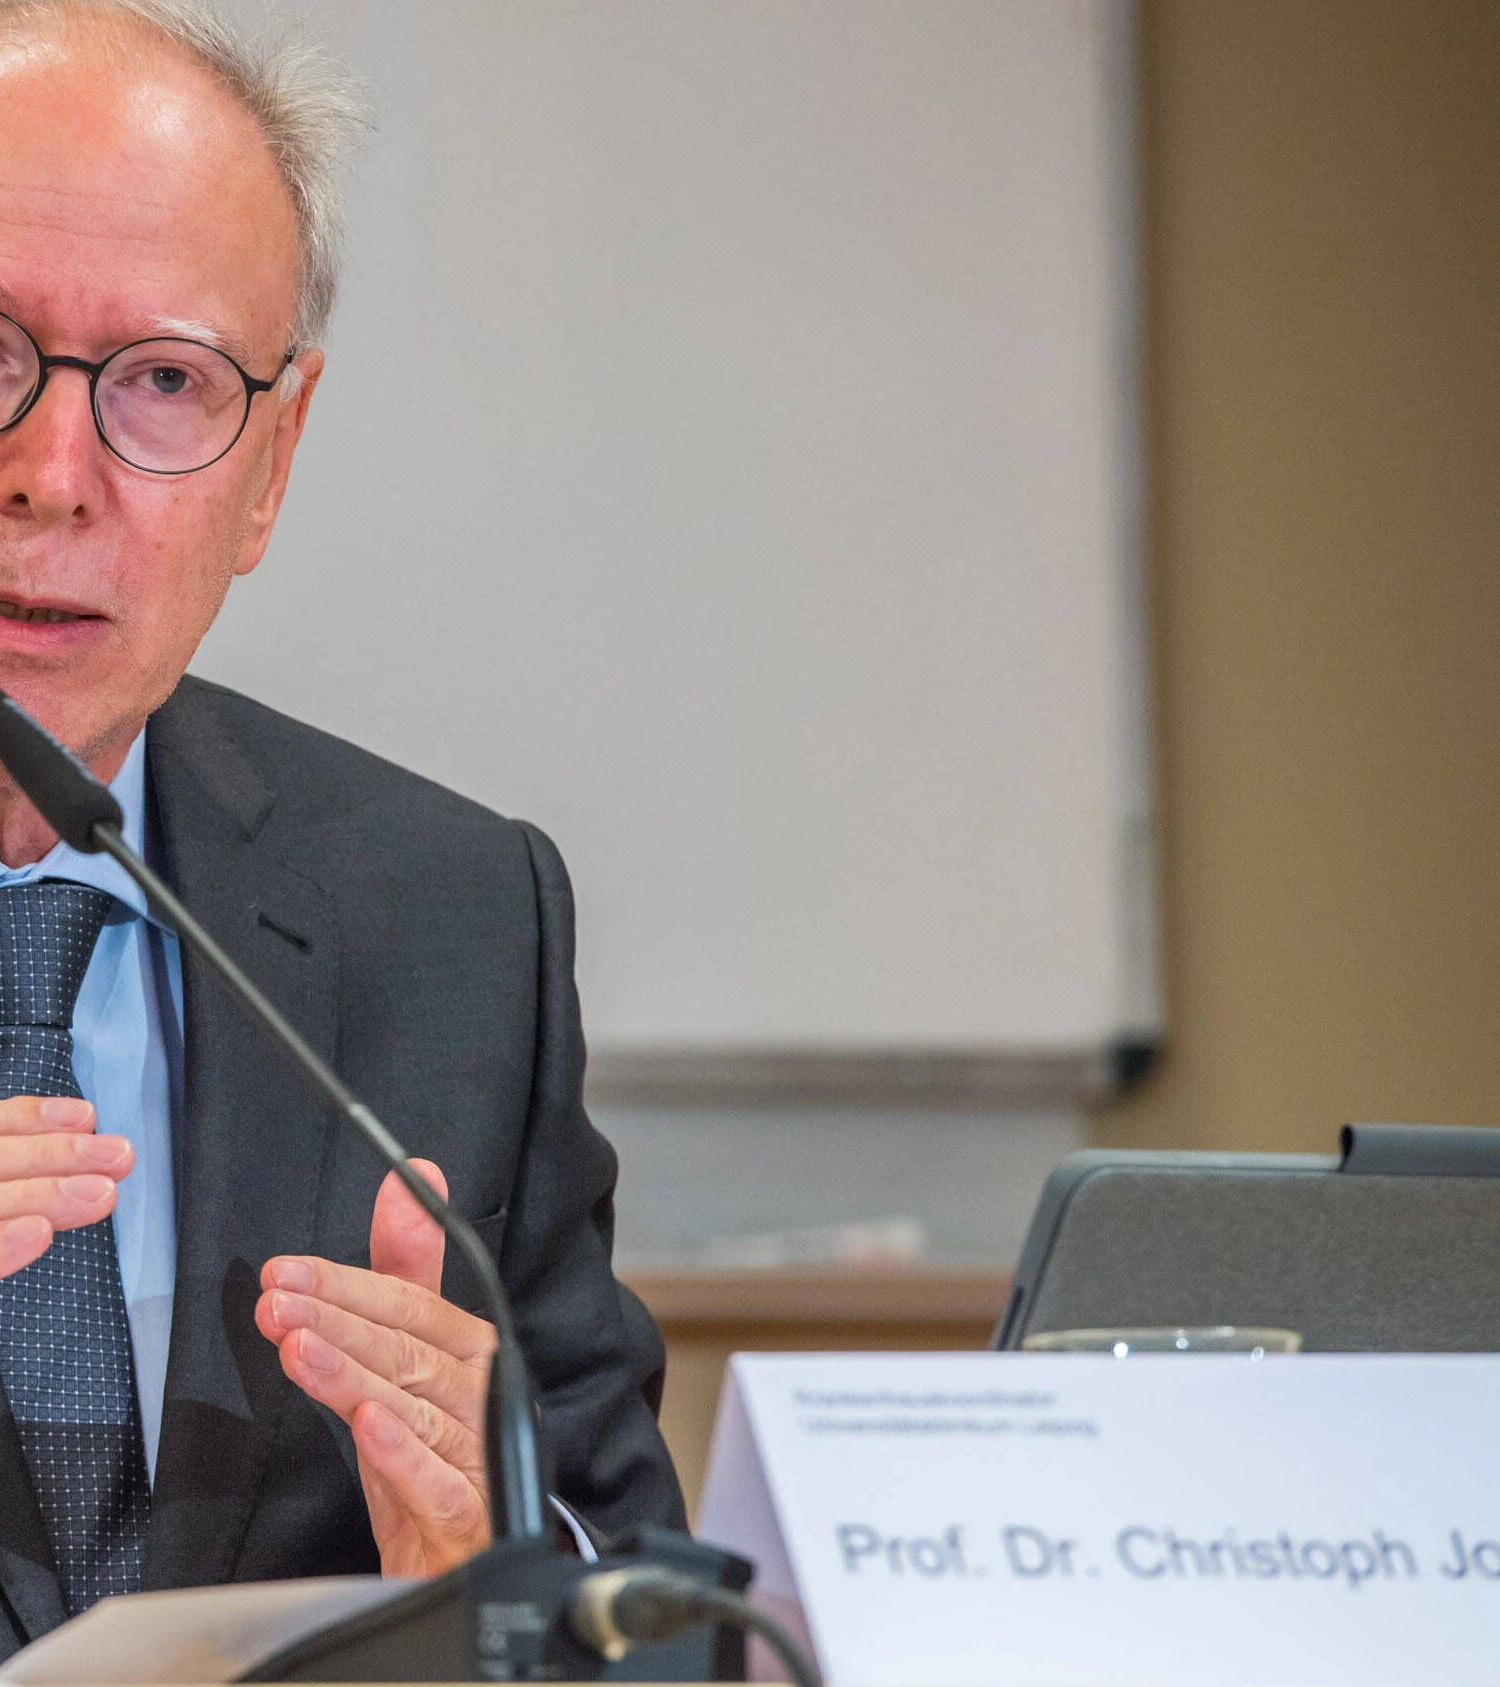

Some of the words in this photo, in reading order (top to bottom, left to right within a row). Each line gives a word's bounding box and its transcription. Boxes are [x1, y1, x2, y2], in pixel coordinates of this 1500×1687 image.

[834, 1522, 989, 1580] Prof.
[999, 1522, 1101, 1580] Dr.
[1114, 1523, 1420, 1591] Christoph
